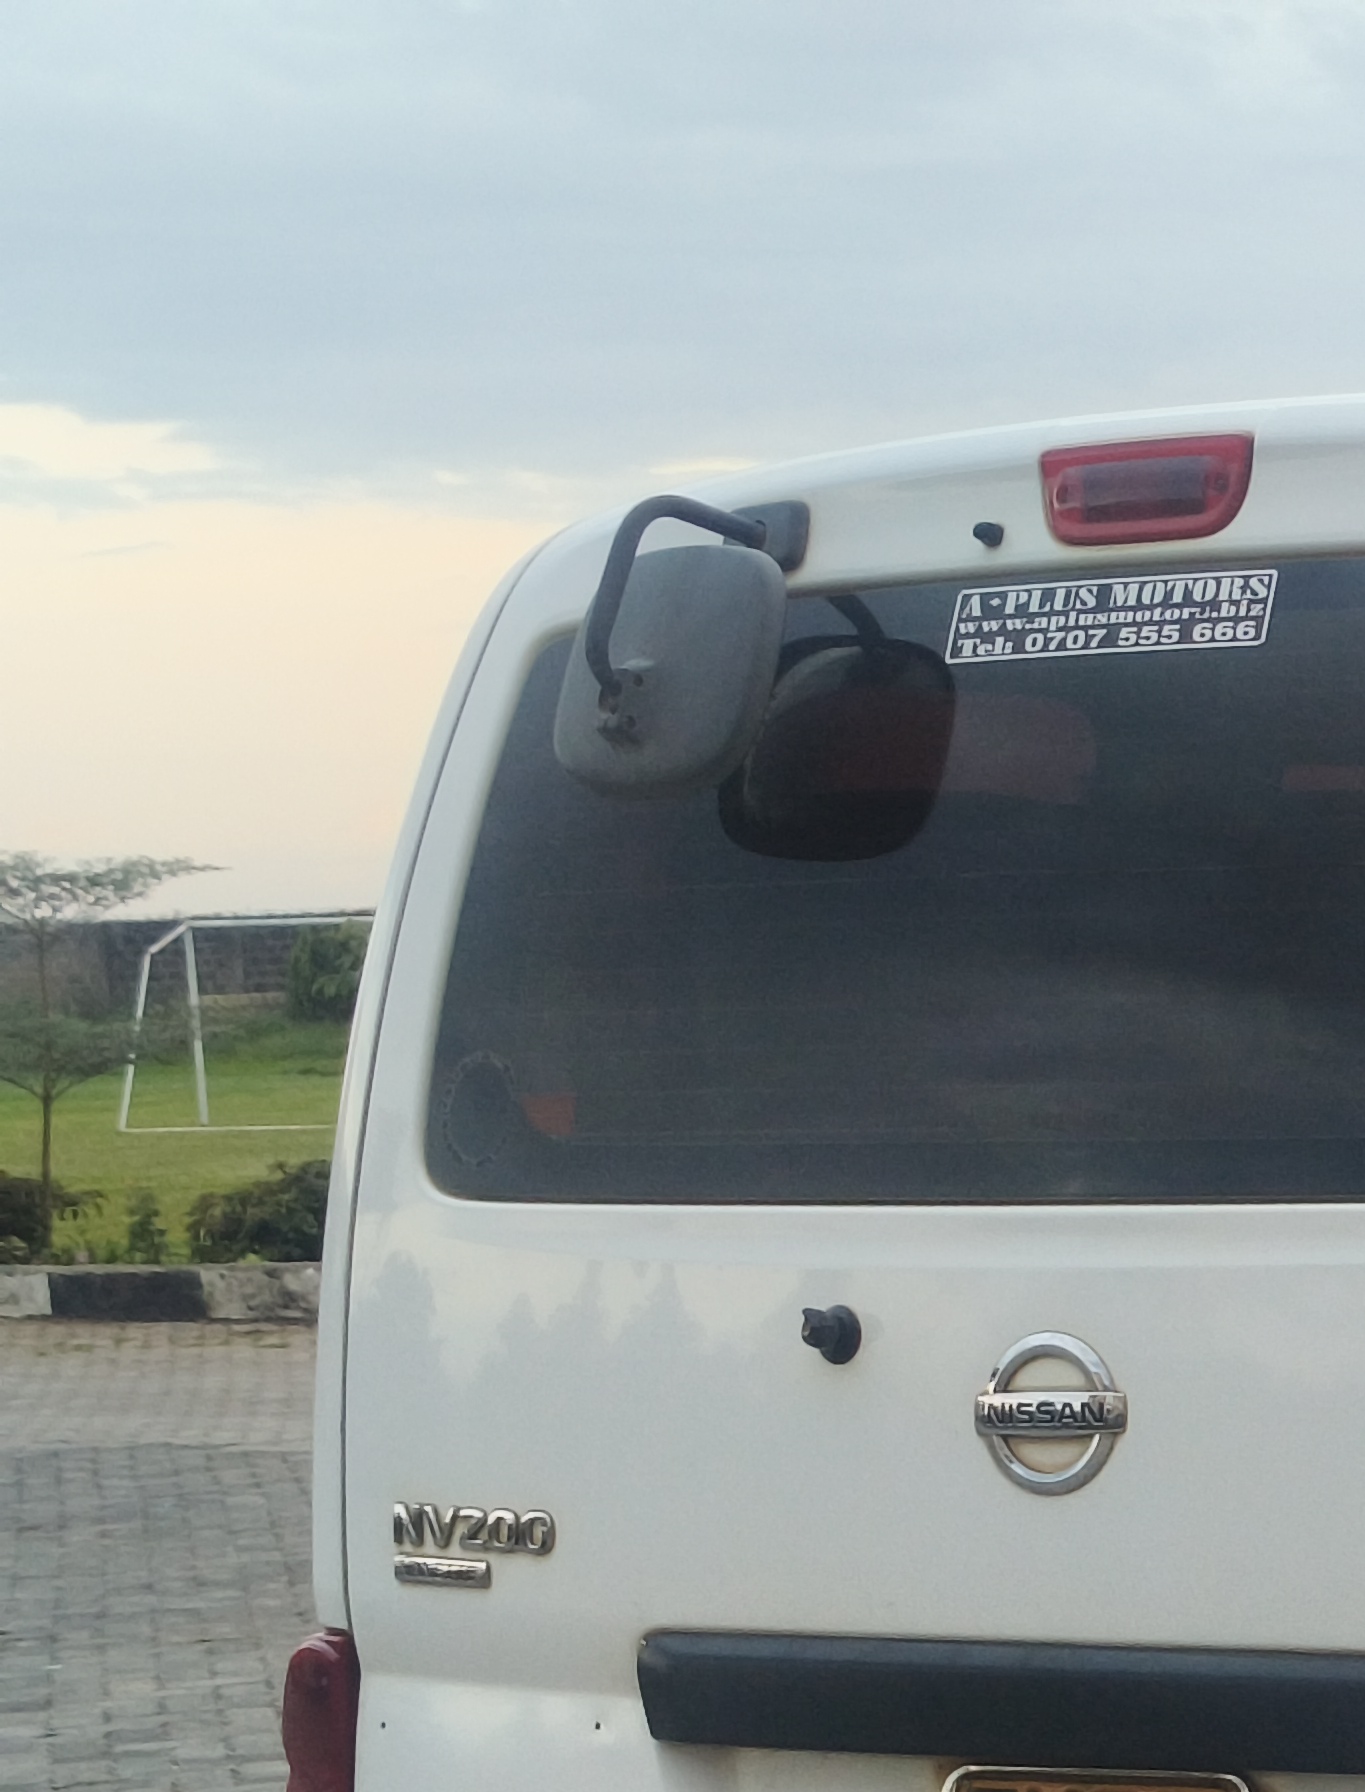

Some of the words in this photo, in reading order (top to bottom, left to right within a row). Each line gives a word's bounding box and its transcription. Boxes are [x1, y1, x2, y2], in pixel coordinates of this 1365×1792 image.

[1109, 576, 1270, 608] MOTORS
[1025, 629, 1107, 652] 0707
[1118, 624, 1180, 646] 555
[1192, 621, 1257, 642] 666
[986, 1401, 1105, 1425] NISSAN
[393, 1501, 556, 1556] NV200
